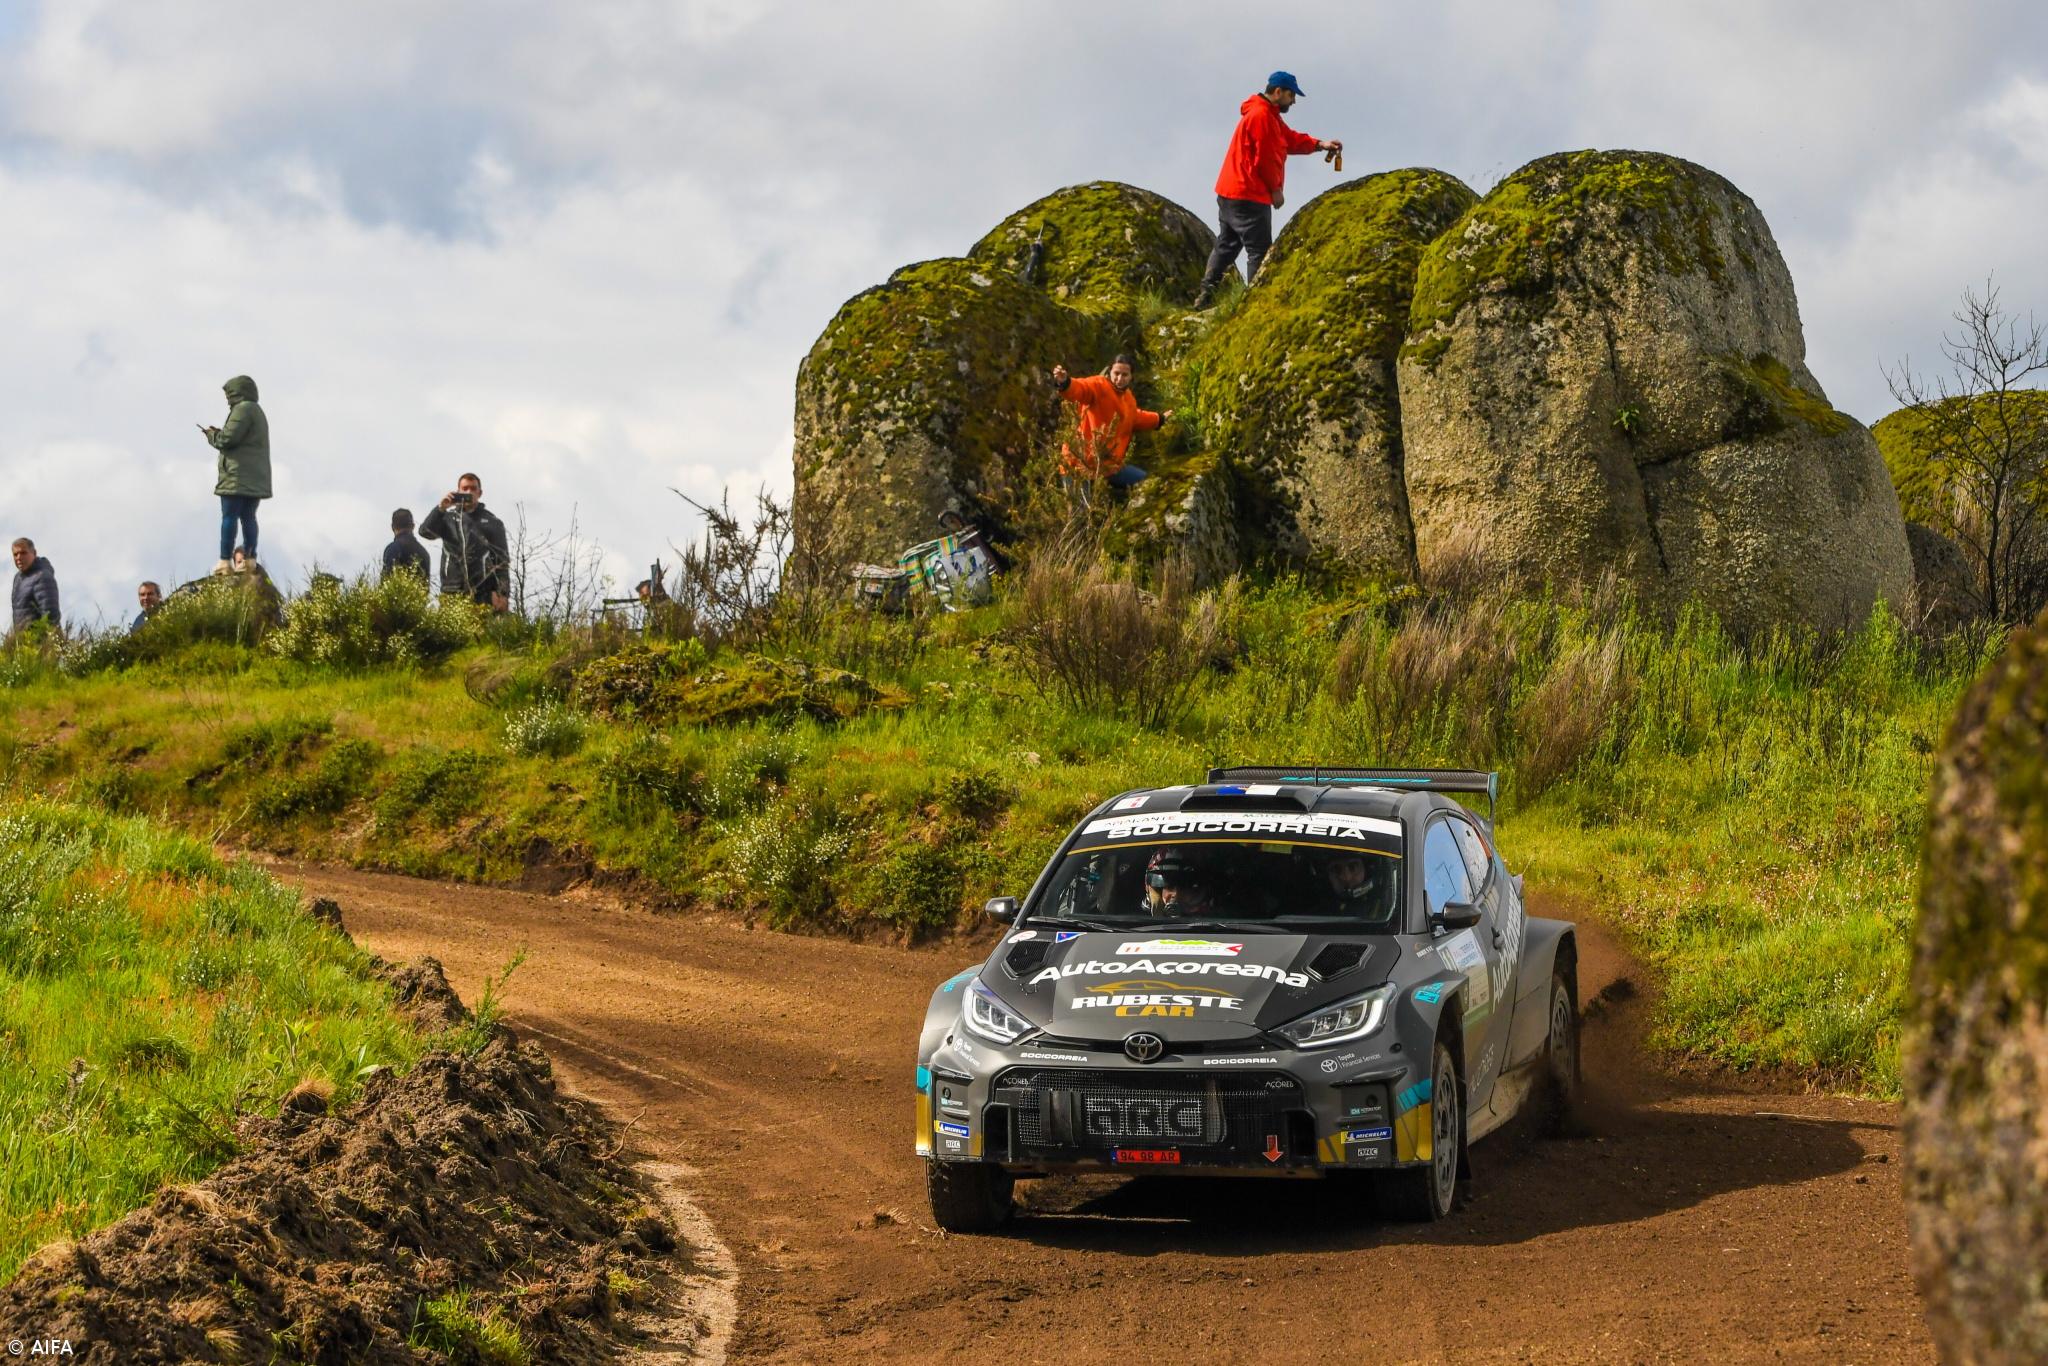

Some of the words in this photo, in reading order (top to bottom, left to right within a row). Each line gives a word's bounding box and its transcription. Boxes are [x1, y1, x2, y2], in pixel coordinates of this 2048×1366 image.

[1107, 820, 1366, 840] SOCICORREIA
[1029, 959, 1309, 988] AutoAçoreana
[1071, 994, 1244, 1010] RUBESTE
[1115, 1005, 1195, 1017] CAR
[1020, 1052, 1088, 1062] SOCICORREIA
[1203, 1056, 1278, 1065] SOCICORREIA
[1338, 1052, 1355, 1062] Toyota
[1355, 1130, 1388, 1139] MICHELIN
